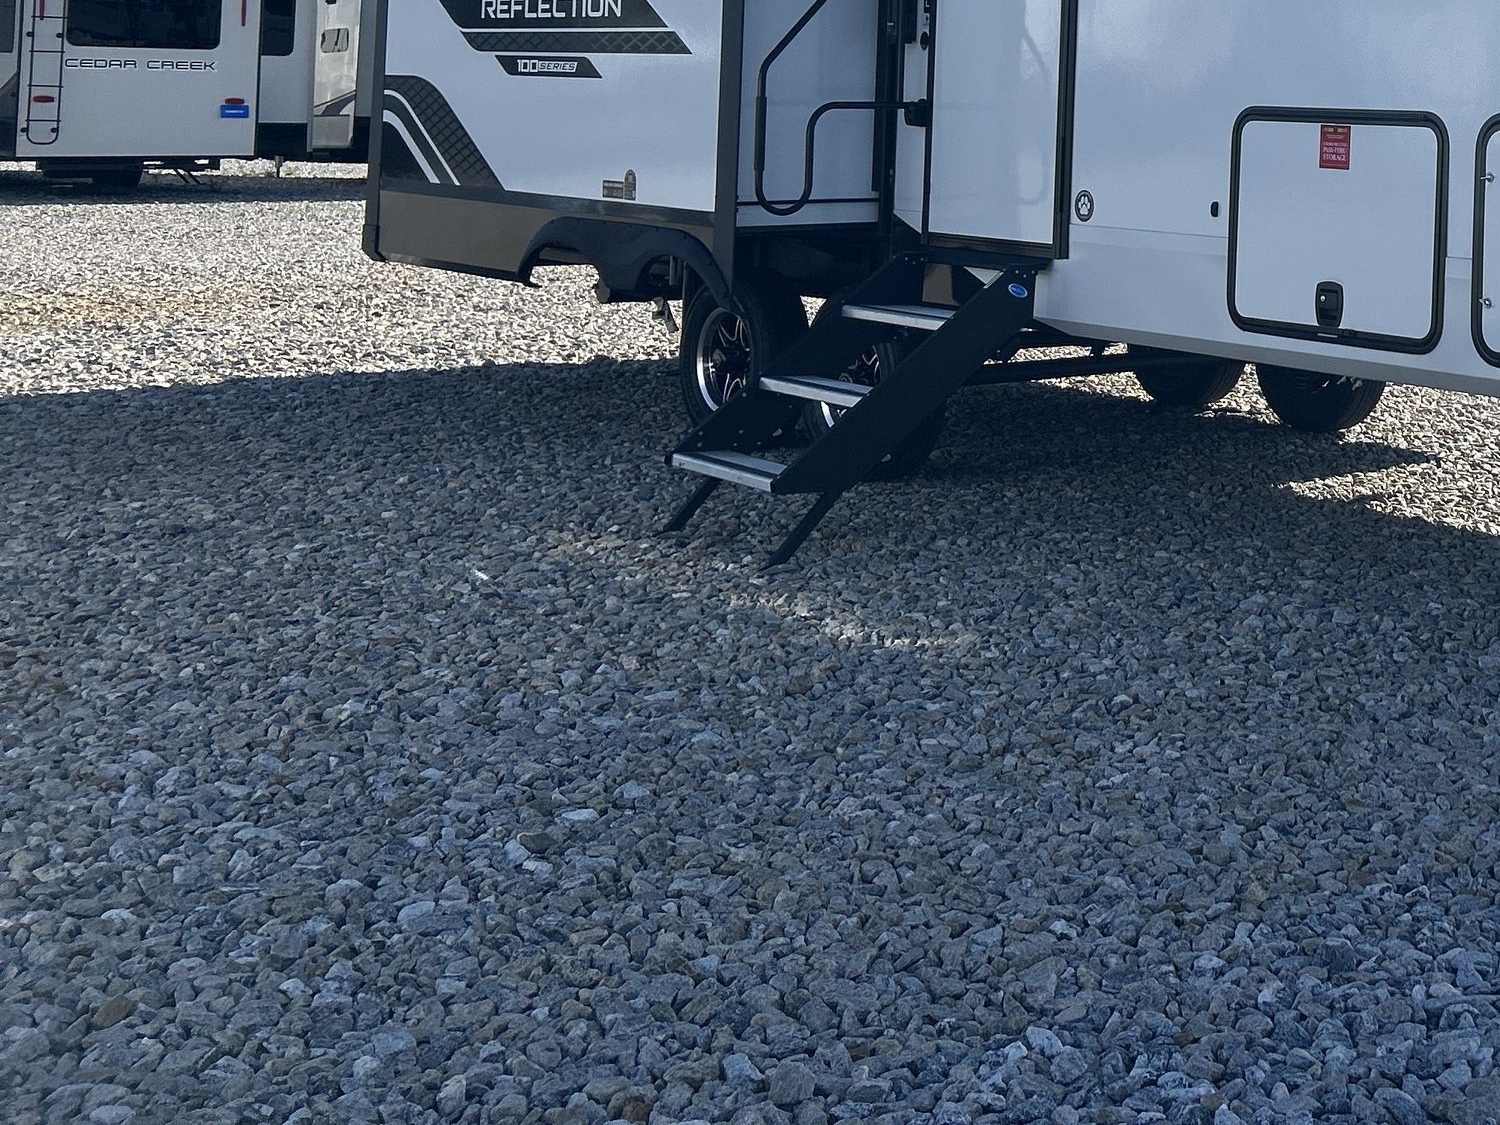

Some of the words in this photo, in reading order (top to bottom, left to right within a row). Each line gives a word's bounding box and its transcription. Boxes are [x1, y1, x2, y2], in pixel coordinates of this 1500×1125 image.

[64, 58, 138, 69] CEDAR
[146, 60, 216, 71] CREEK
[516, 59, 539, 73] 100
[539, 62, 577, 72] SERIES
